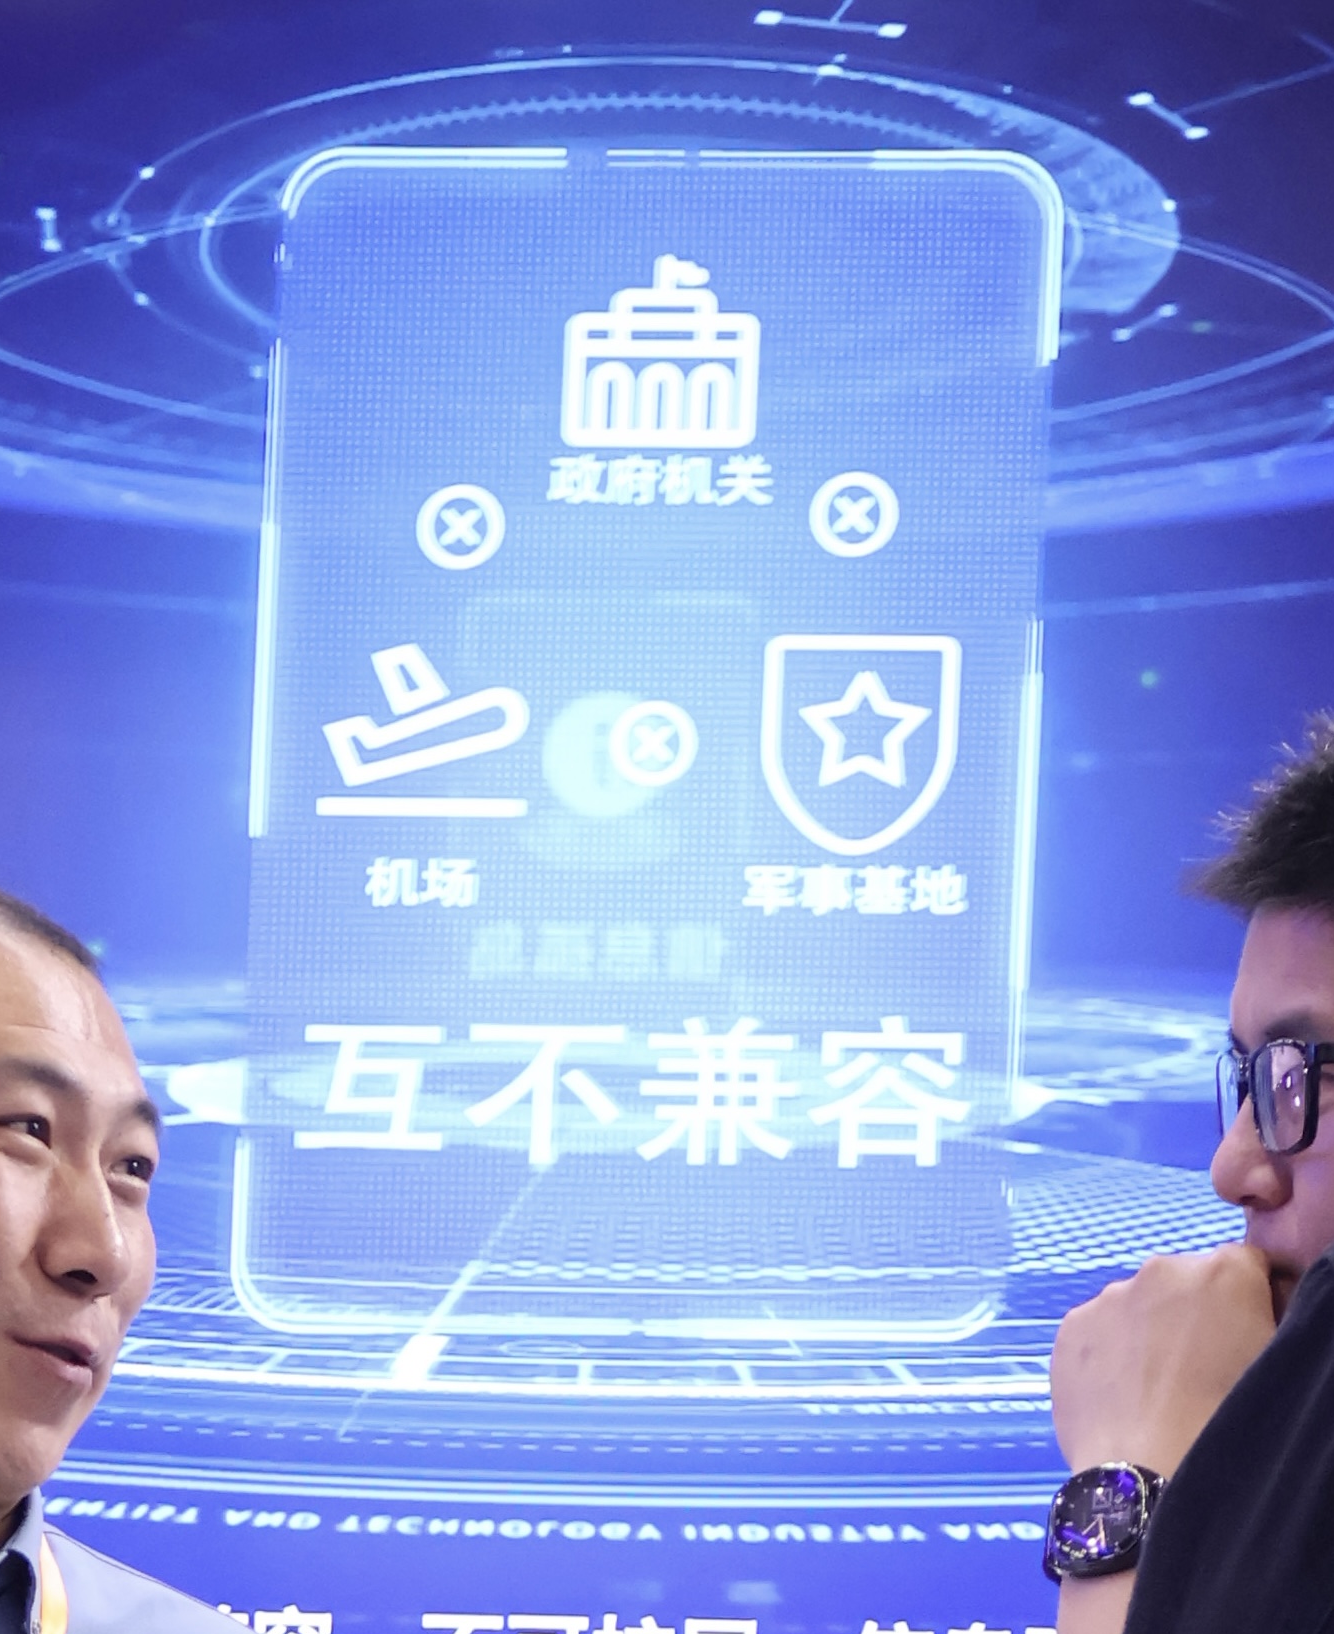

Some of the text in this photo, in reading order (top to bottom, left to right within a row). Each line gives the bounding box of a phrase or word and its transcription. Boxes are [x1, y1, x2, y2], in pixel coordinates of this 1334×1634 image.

[546, 454, 774, 506] 政府机关
[365, 856, 481, 908] 机场
[742, 863, 968, 915] 军事基地
[293, 1016, 972, 1169] 互不兼容
